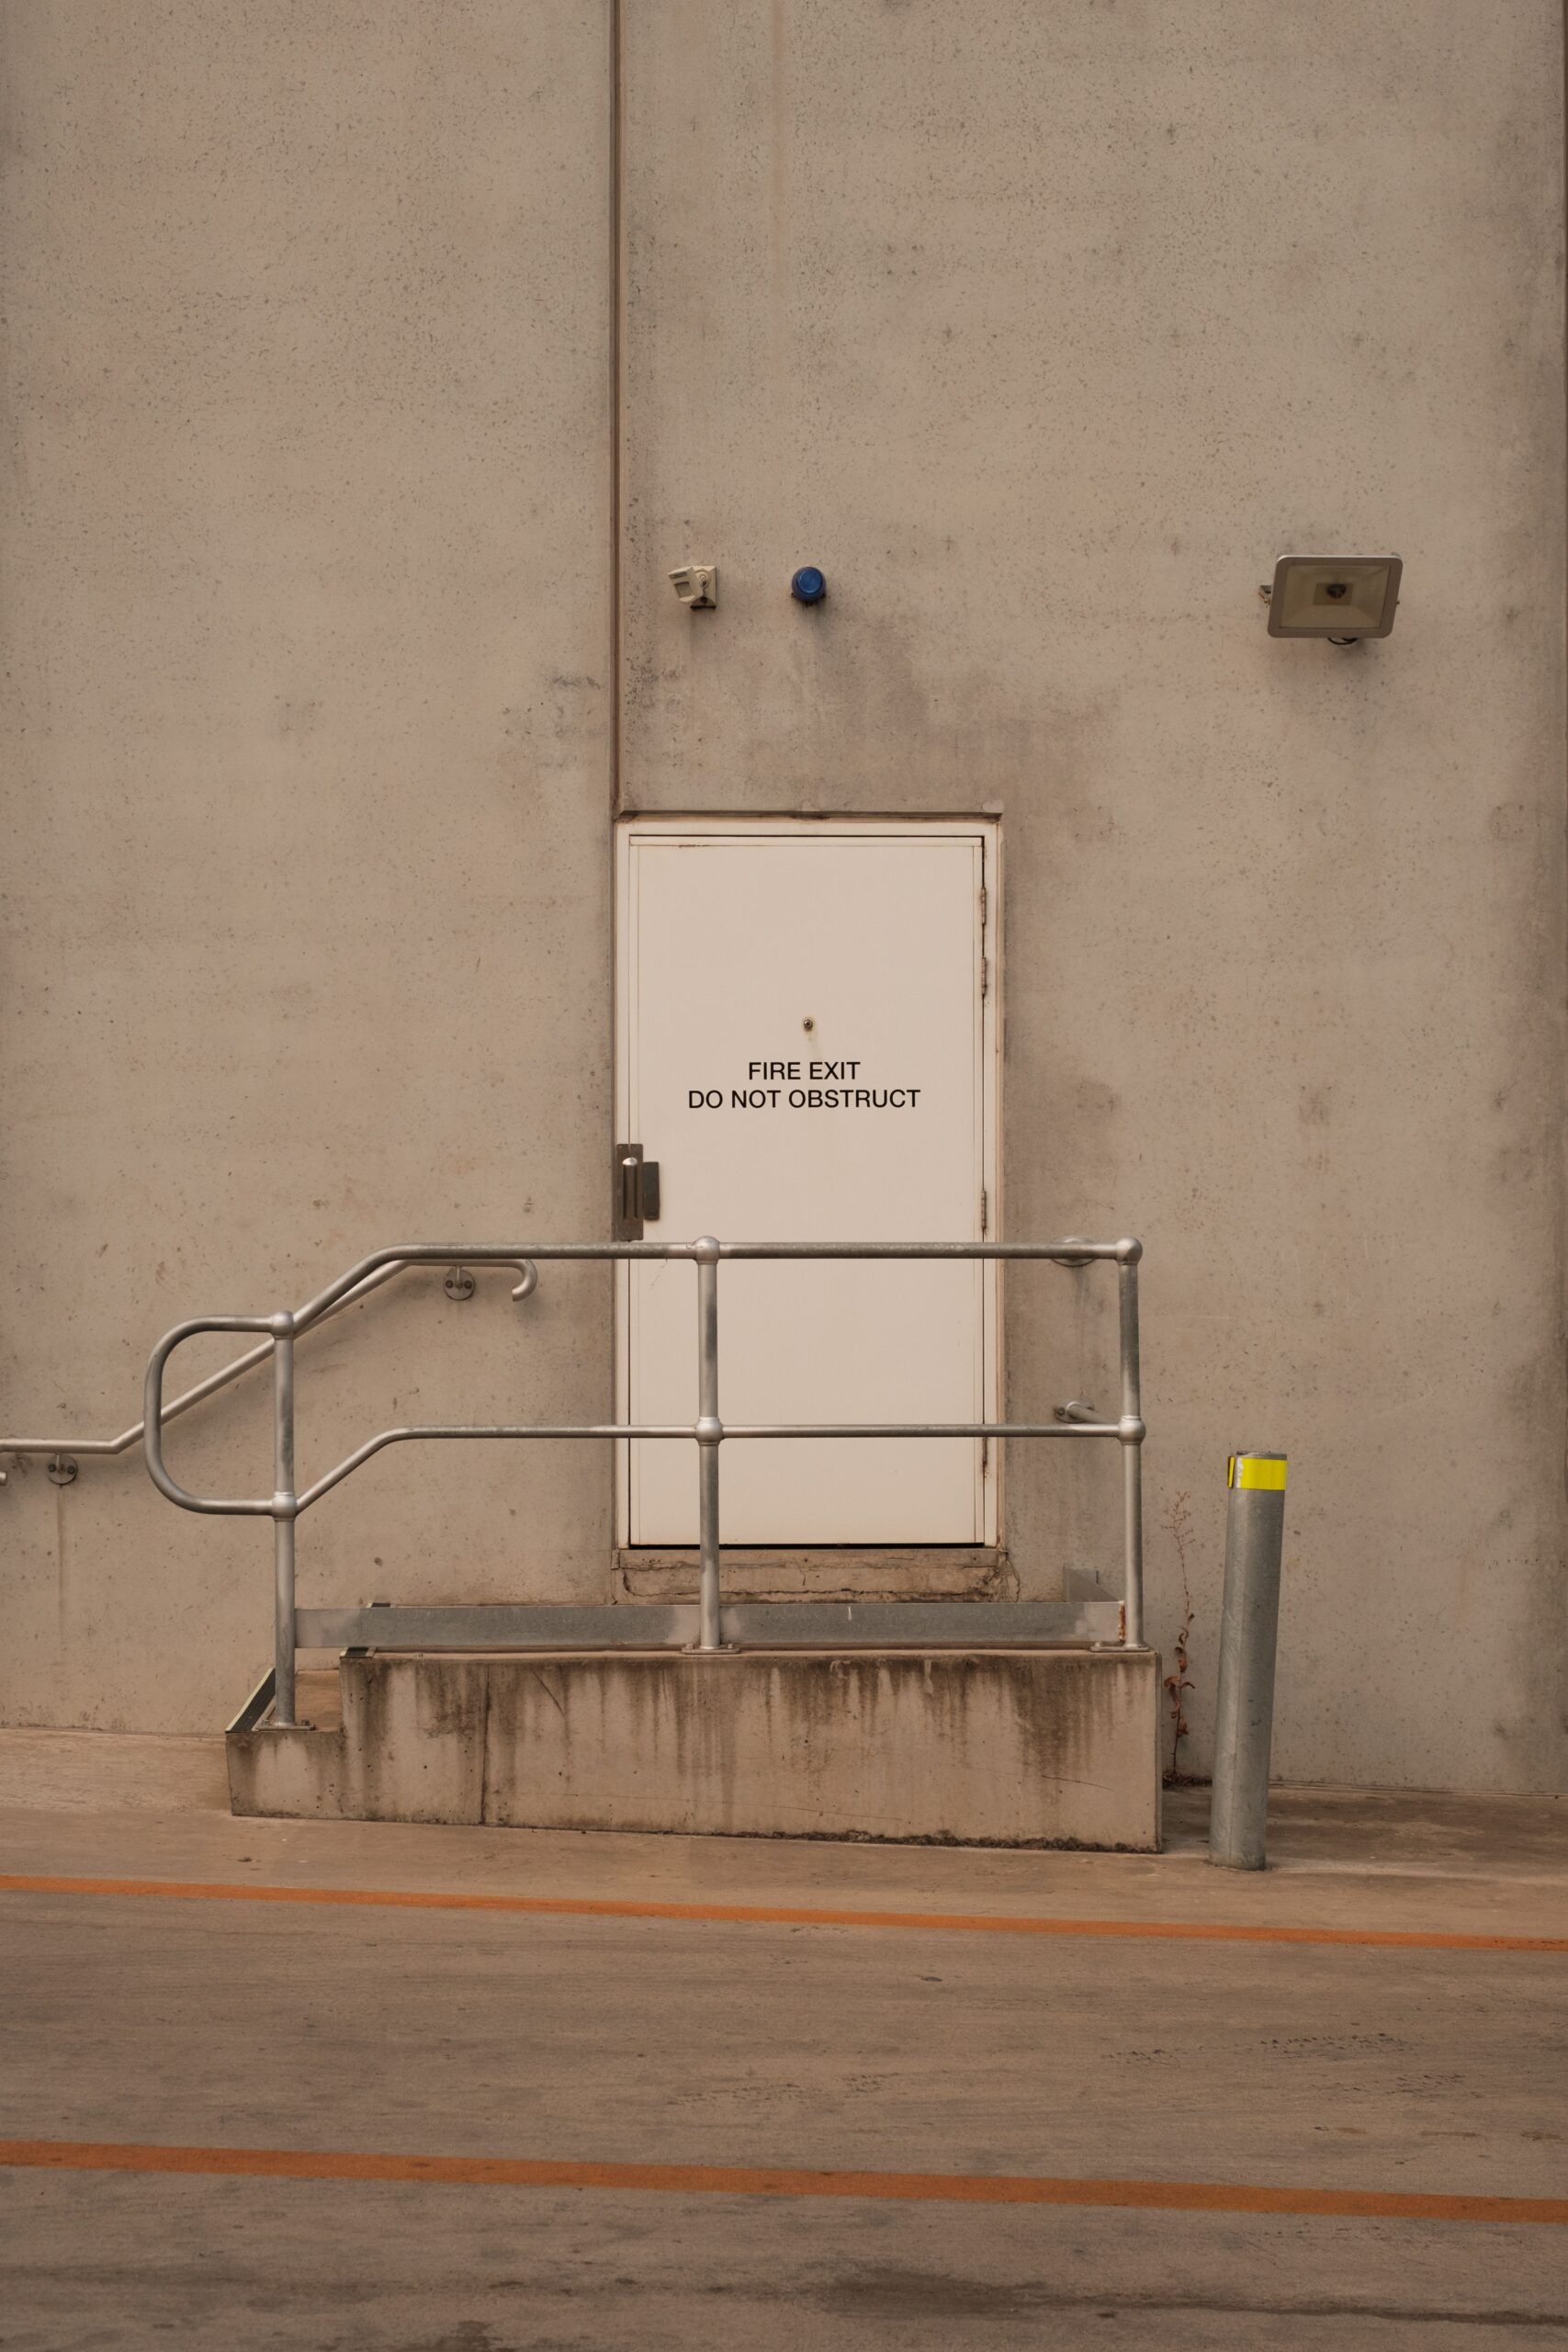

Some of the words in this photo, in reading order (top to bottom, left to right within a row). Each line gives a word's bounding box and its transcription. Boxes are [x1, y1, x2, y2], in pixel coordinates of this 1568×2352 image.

[749, 1061, 802, 1080] FIRE
[809, 1061, 862, 1080] EXIT
[688, 1090, 724, 1109] DO
[731, 1089, 782, 1109] NOT
[788, 1089, 921, 1109] OBSTRUCT
